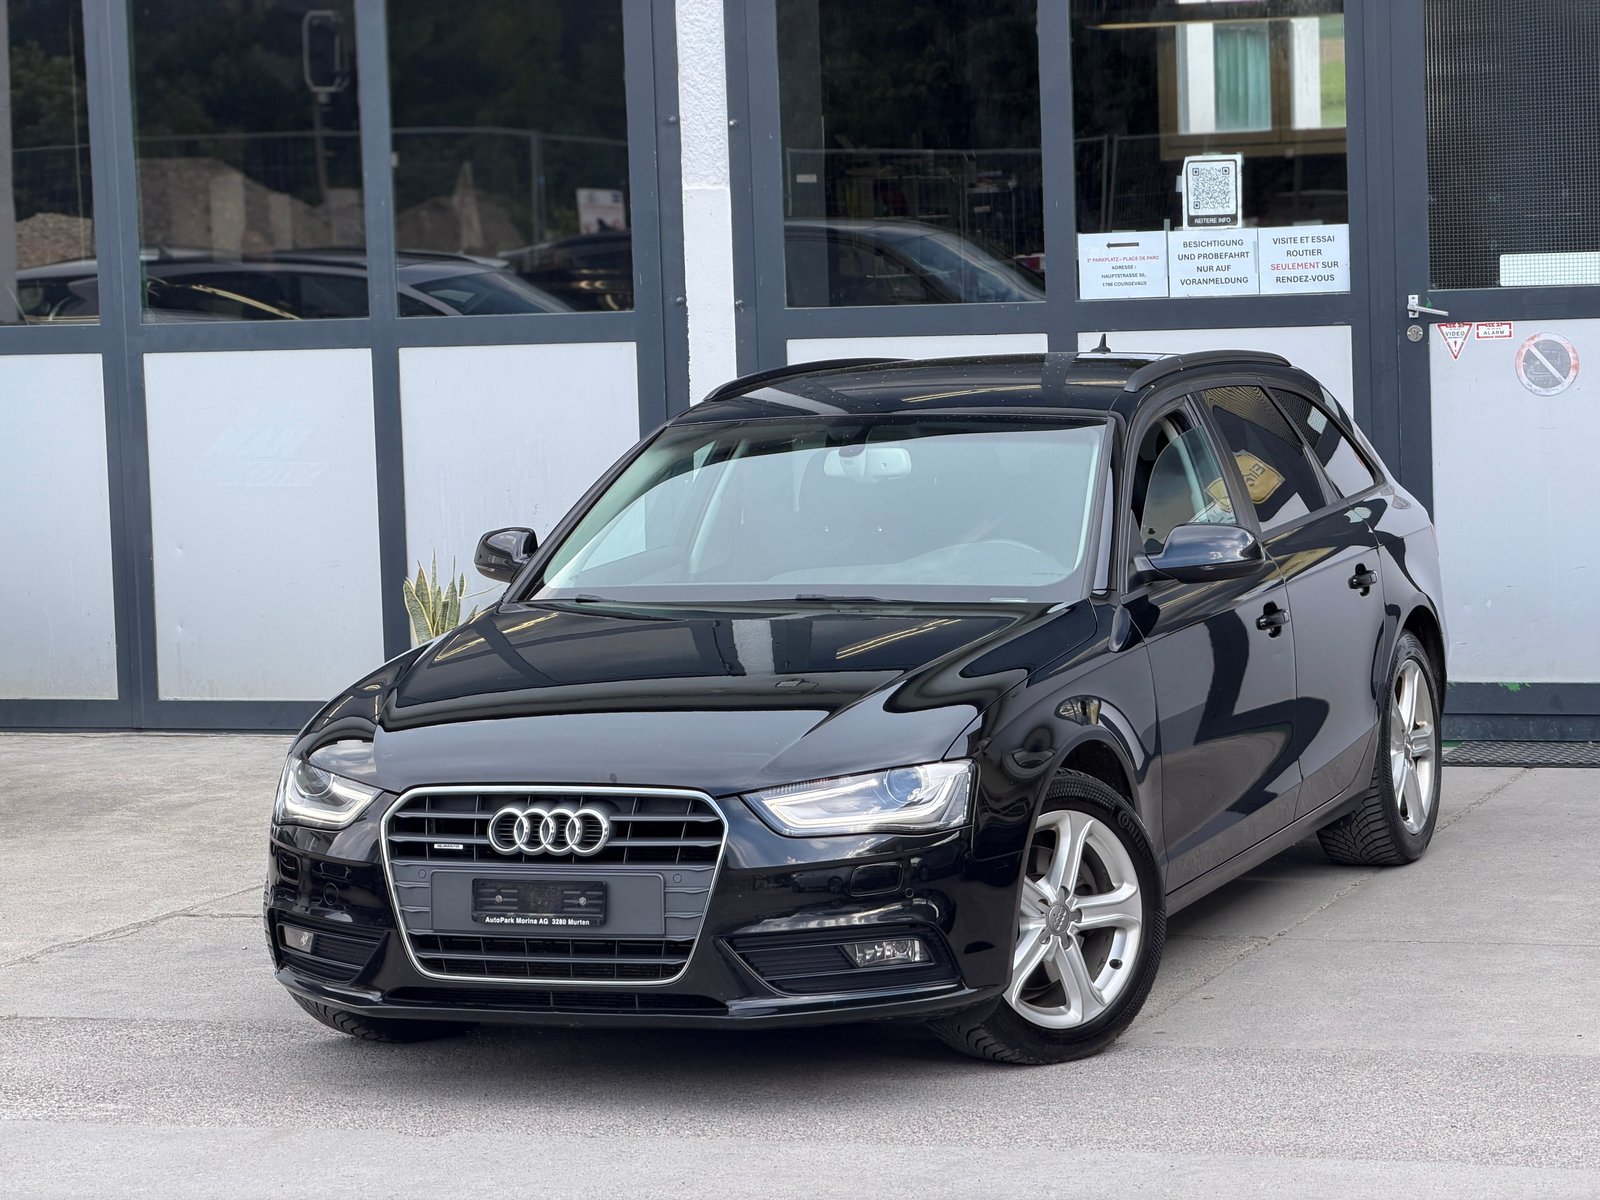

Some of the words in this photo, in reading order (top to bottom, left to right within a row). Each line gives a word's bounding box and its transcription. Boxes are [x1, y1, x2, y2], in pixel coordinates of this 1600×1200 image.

[1183, 239, 1244, 248] BESICHTIGUNG
[1272, 236, 1298, 244] VISITE
[1311, 235, 1335, 243] ESSAI
[1197, 251, 1250, 260] PROBEFAHRT
[1286, 249, 1322, 257] ROUTIER
[1270, 262, 1320, 271] SEULEMENT
[1322, 261, 1339, 269] SUR
[1180, 276, 1249, 286] VORANMELDUNG
[1276, 275, 1335, 283] RENDEZ-VOUS
[485, 916, 514, 924] AutoPark
